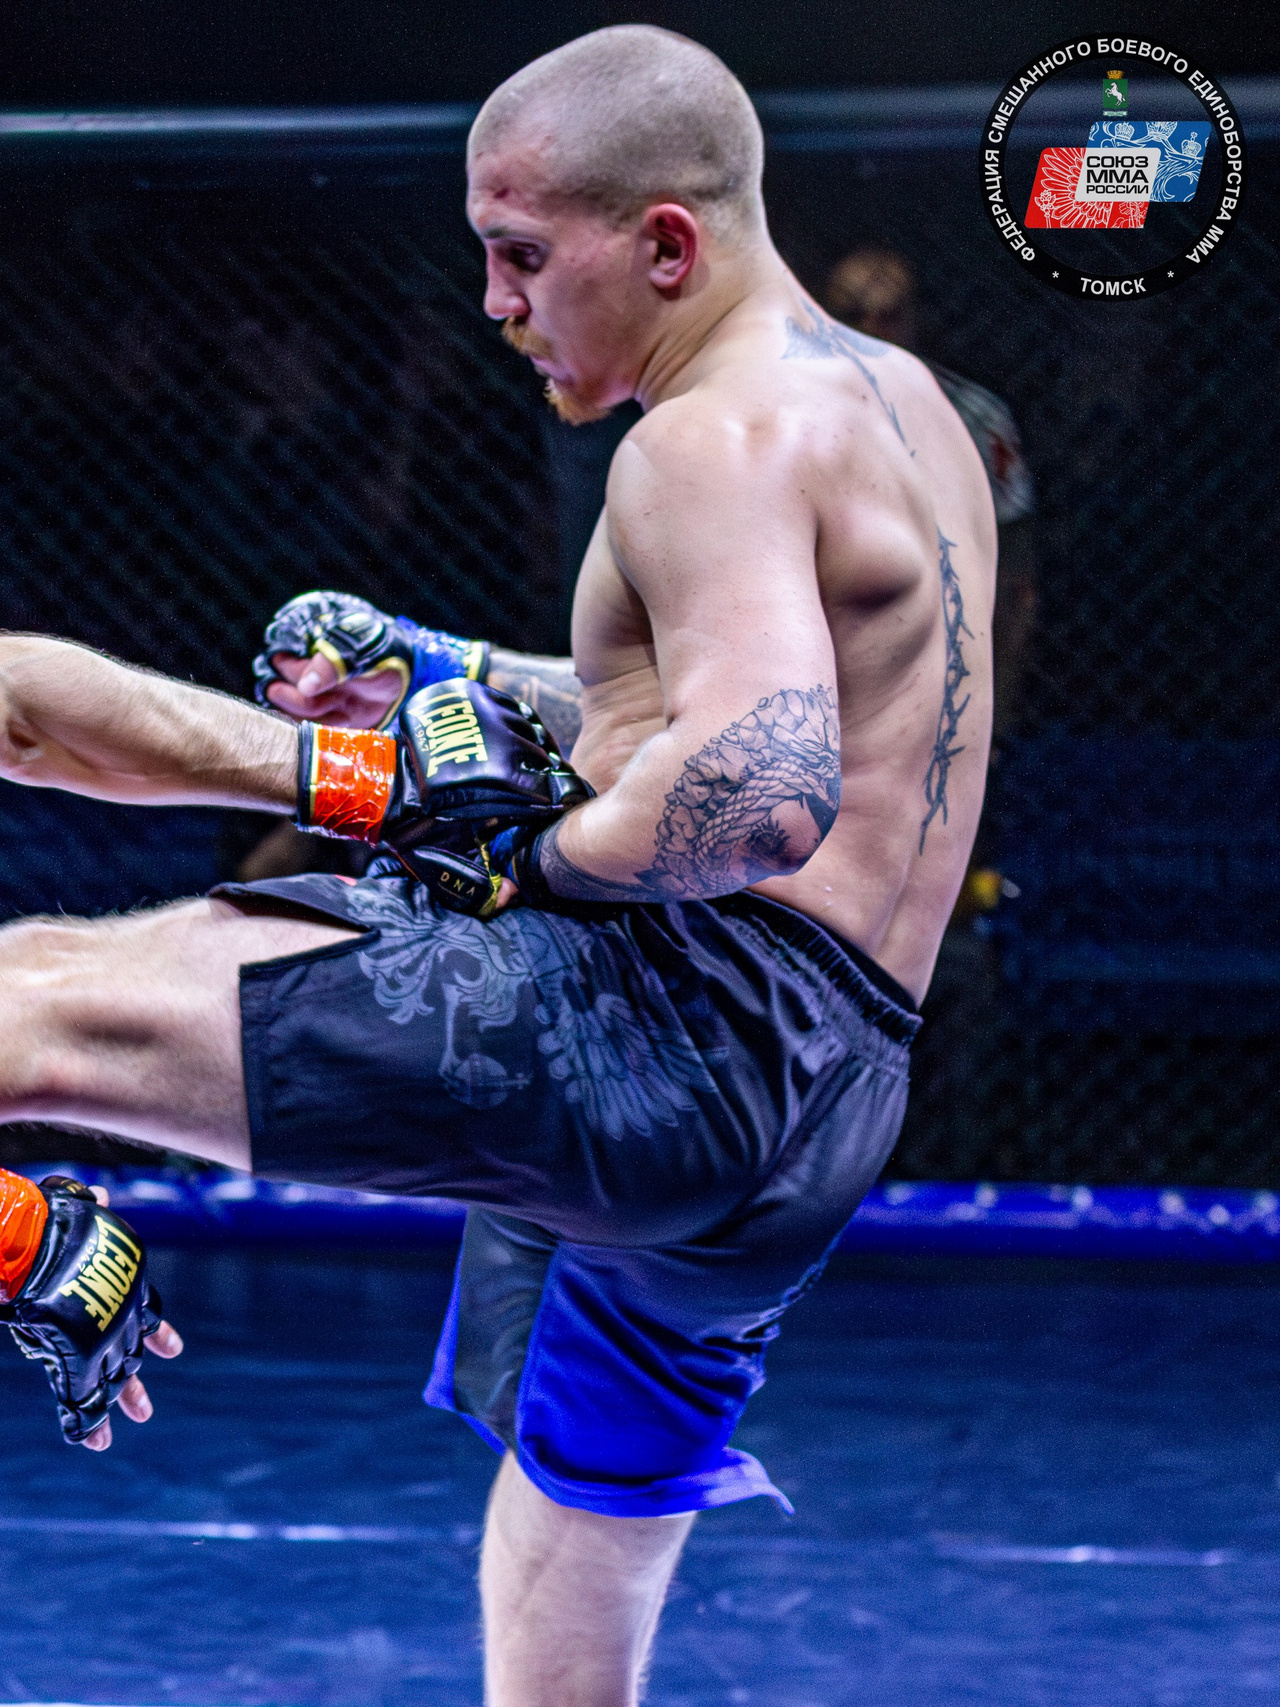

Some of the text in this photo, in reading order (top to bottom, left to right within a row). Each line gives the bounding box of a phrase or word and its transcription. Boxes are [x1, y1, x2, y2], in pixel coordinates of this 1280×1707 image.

[407, 691, 488, 778] LEONE
[414, 723, 429, 752] 1947
[59, 1215, 141, 1332] LEONE
[77, 1238, 97, 1272] 1947
